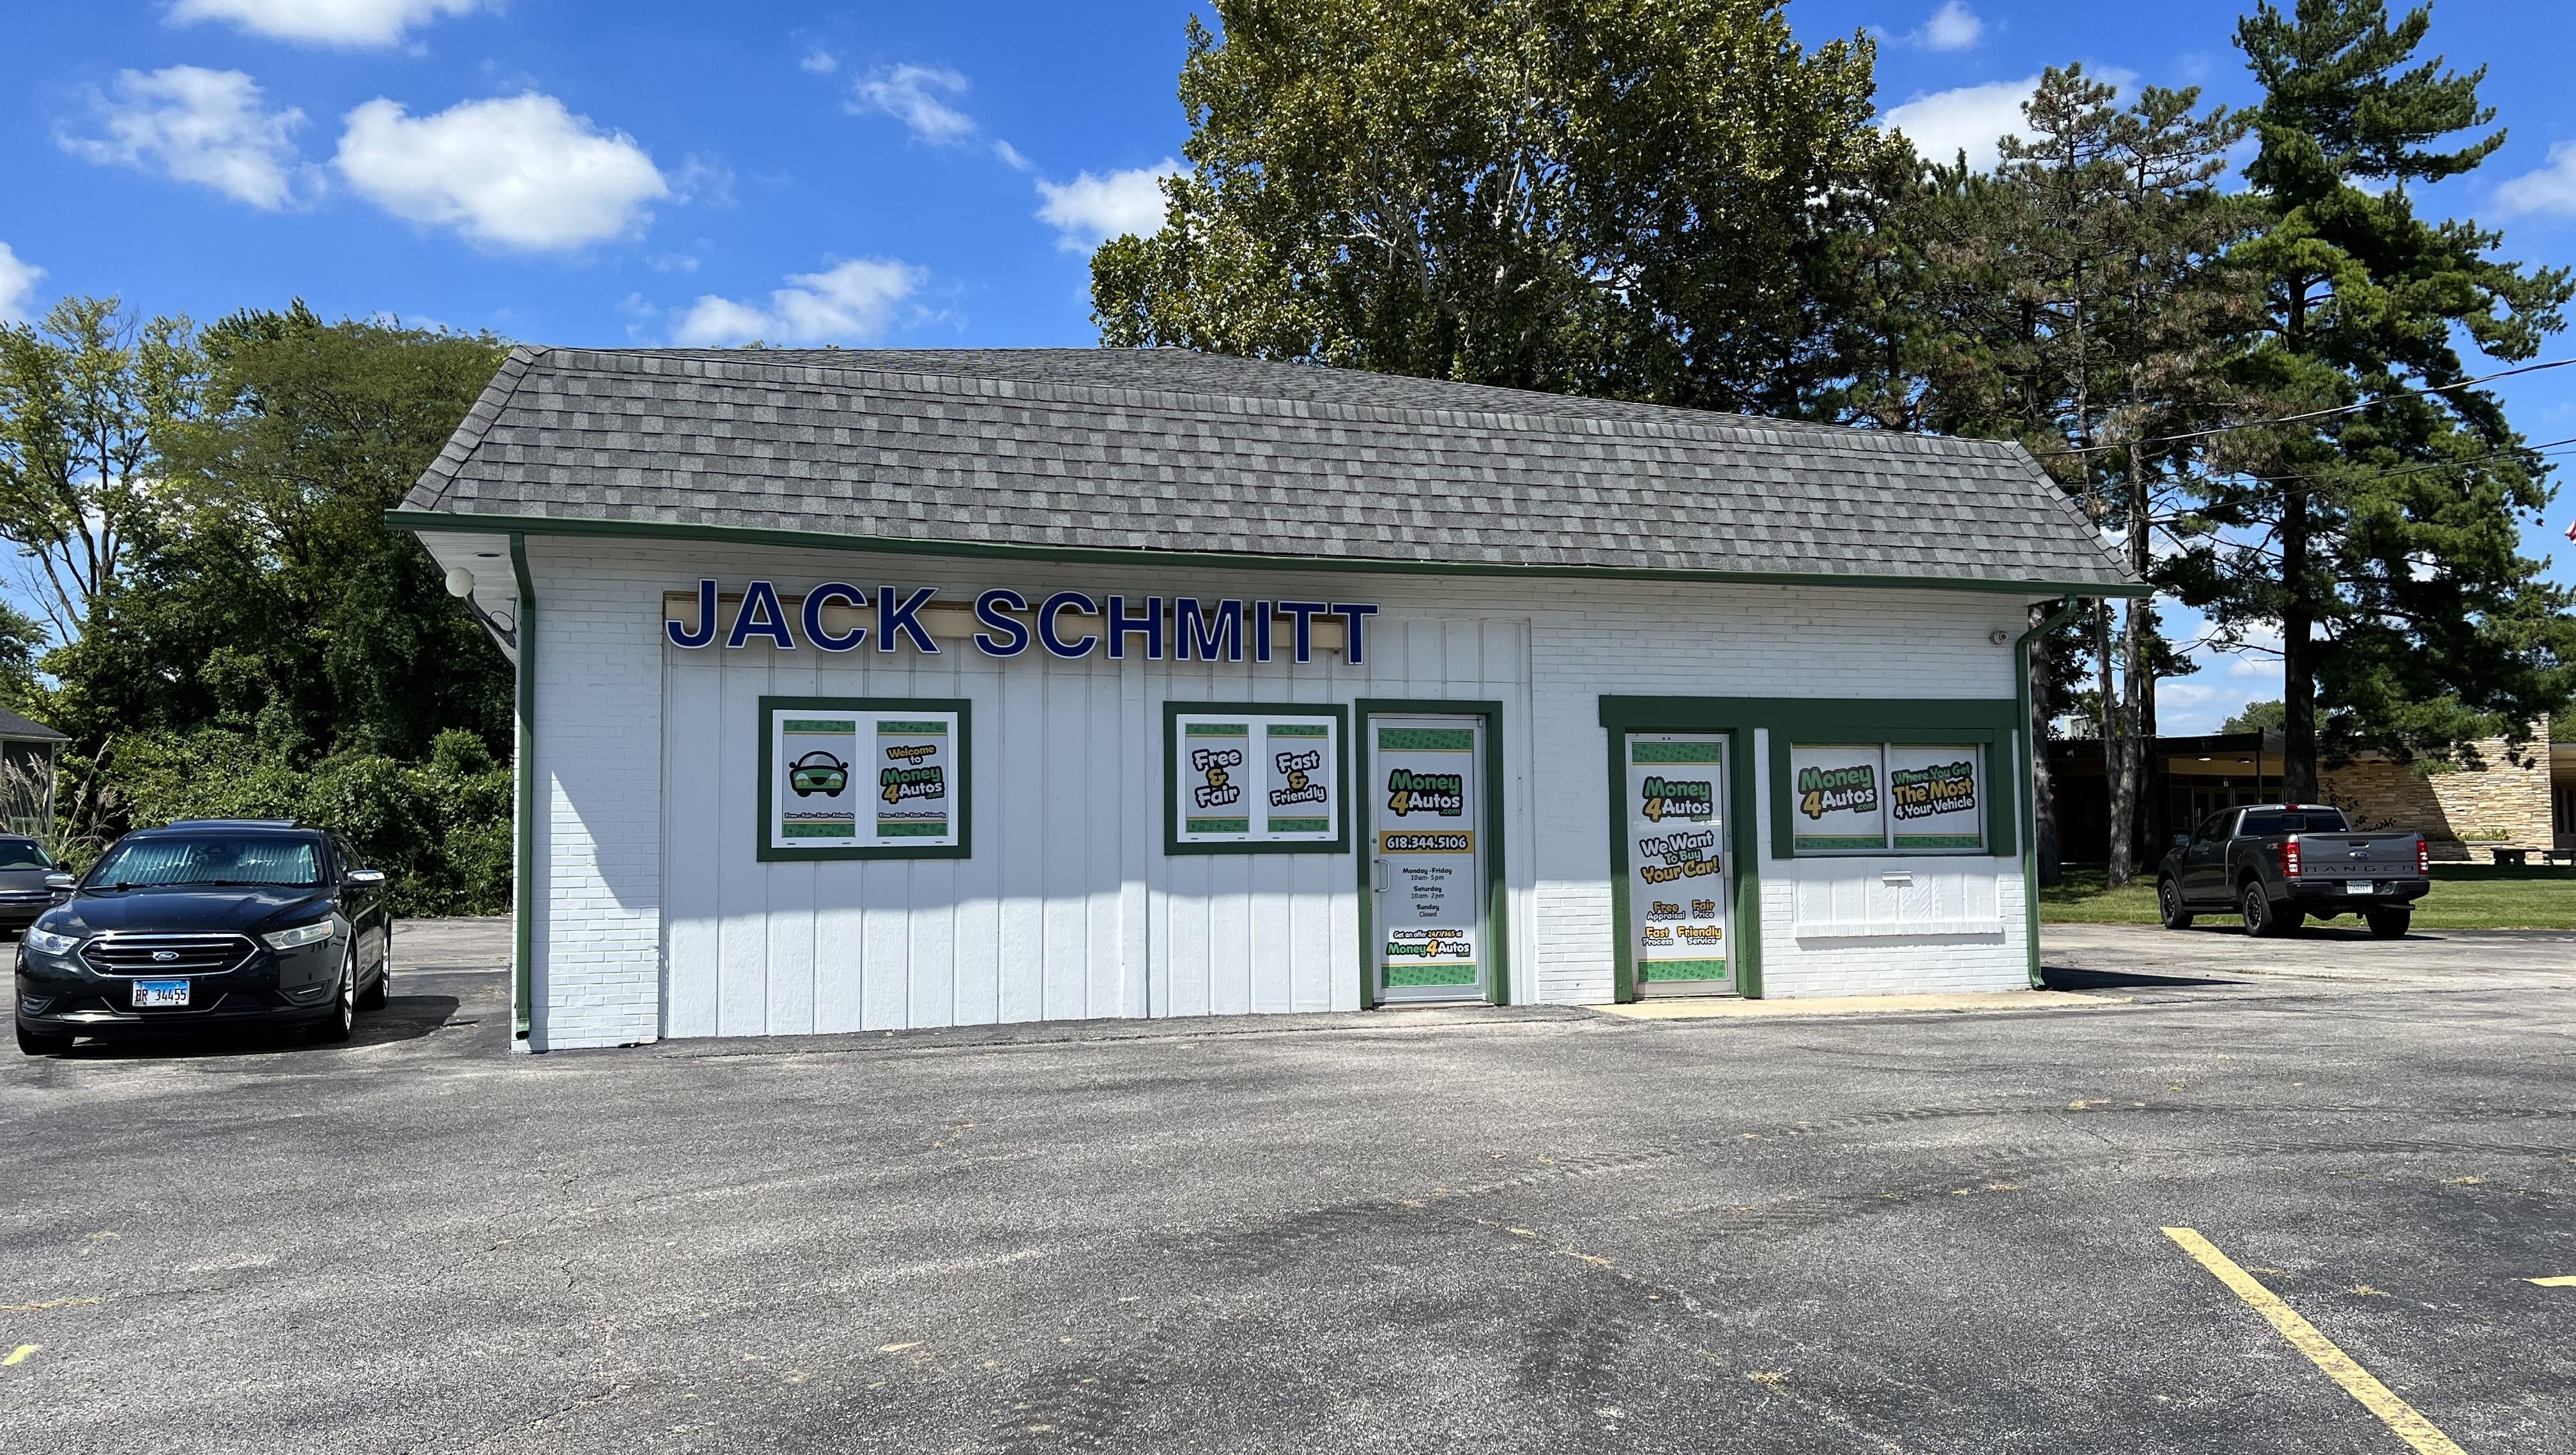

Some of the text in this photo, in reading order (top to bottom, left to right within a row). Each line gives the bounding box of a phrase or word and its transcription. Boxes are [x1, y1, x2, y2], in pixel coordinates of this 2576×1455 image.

[665, 577, 1381, 665] JACK SCHMITT
[887, 745, 935, 759] Welcome
[910, 756, 921, 765] to
[1194, 751, 1240, 769] Free
[1278, 752, 1318, 772] Fast
[882, 768, 941, 784] Money
[1208, 768, 1227, 786] &
[1289, 772, 1307, 789] &
[1801, 768, 1871, 790] Money
[1894, 764, 1970, 784] Where You Get
[884, 782, 942, 802] 4Autos
[1390, 772, 1460, 795] Money
[1644, 779, 1710, 801] Money
[1893, 778, 1972, 805] The Most
[1197, 786, 1238, 807] Fair
[1271, 786, 1325, 805] Friendly
[1390, 791, 1460, 814] 4Autos
[1803, 789, 1874, 816] 4Autos
[1644, 798, 1710, 820] 4Autos
[1855, 802, 1876, 812] .com
[1896, 796, 1974, 818] 4 Your Vehicle
[1386, 837, 1467, 849] 618.344.5106
[1641, 832, 1713, 856] We Want
[1665, 850, 1702, 864] To Buy
[1642, 857, 1719, 883] Your Car!
[2304, 865, 2414, 873] RANGER
[1653, 902, 1678, 912] Free
[1692, 900, 1715, 911] Fair
[1646, 911, 1685, 921] Appraisal
[1646, 927, 1669, 937] Fast
[1677, 926, 1721, 939] Friendly
[1388, 940, 1469, 956] Money4Autos
[135, 987, 187, 1002] BR 34455
